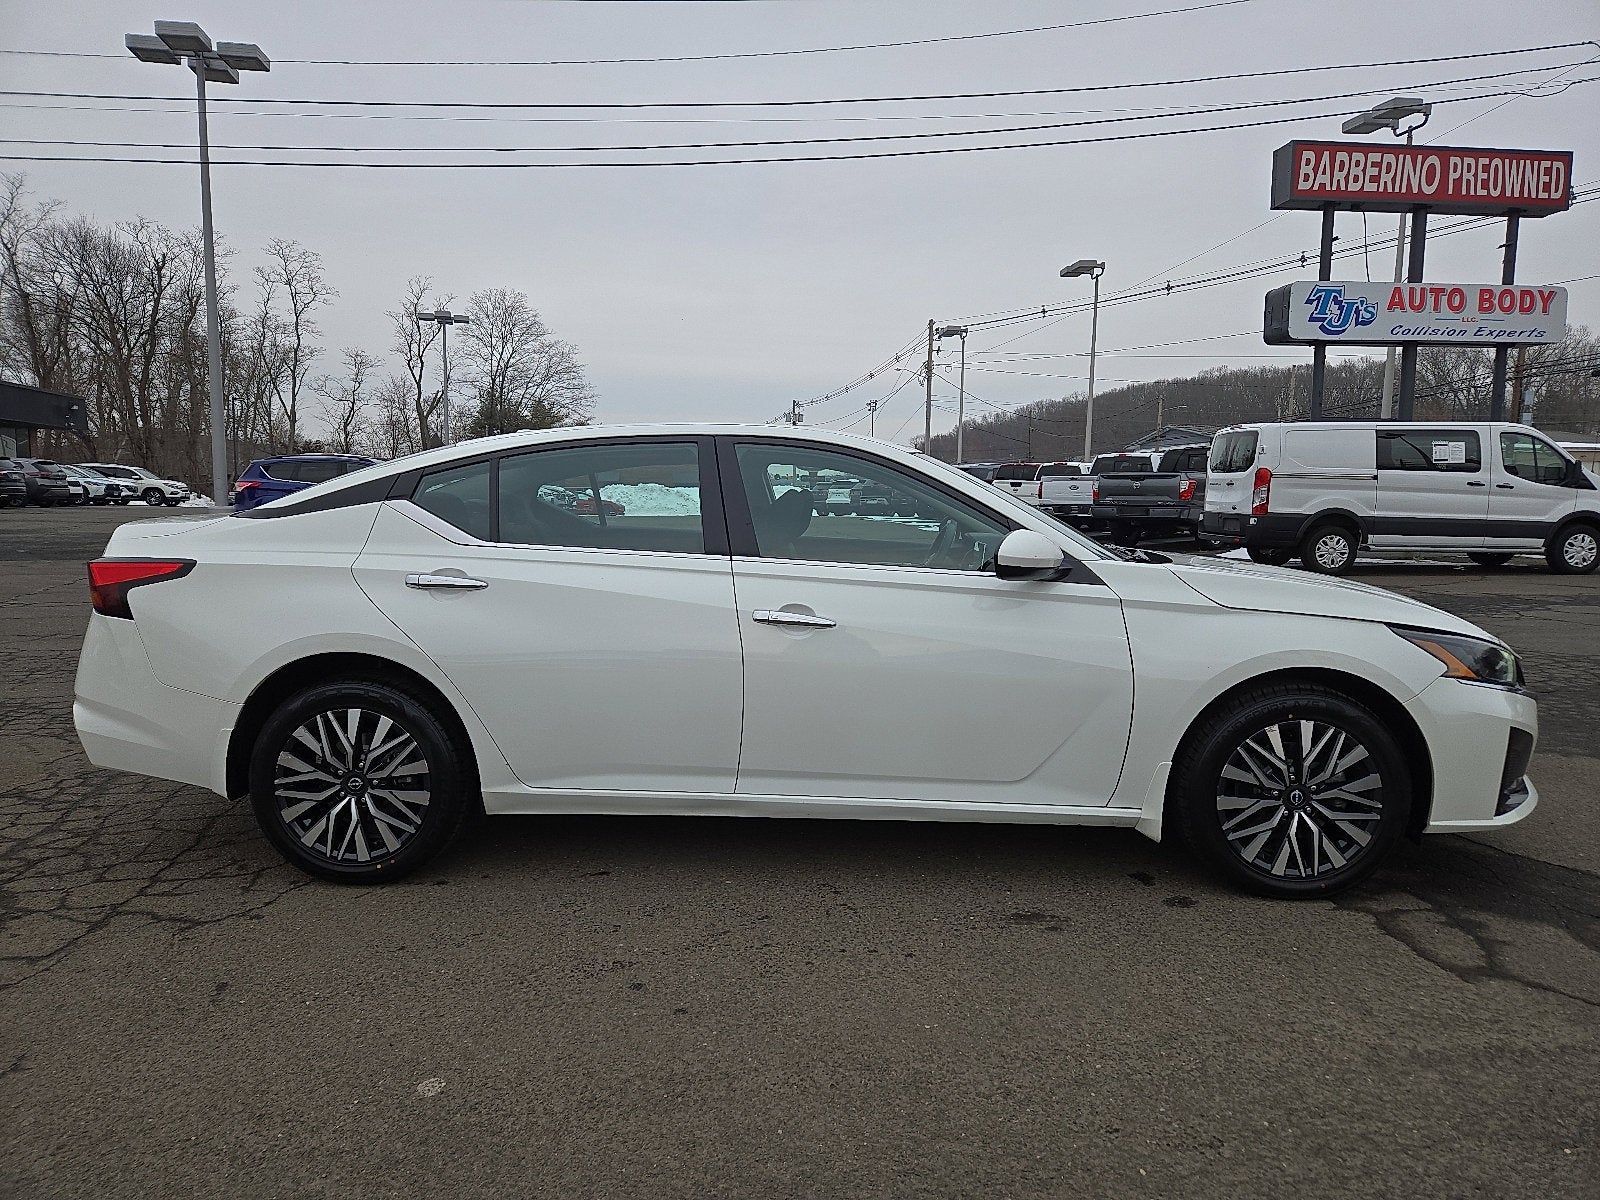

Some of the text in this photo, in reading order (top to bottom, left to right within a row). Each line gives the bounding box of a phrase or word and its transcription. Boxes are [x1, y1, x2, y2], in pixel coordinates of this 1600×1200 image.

[1297, 150, 1565, 200] BARBERINO PREOWNED
[1304, 284, 1379, 336] TJ's
[1386, 286, 1556, 315] AUTO BODY
[1390, 324, 1547, 340] Collision Experts
